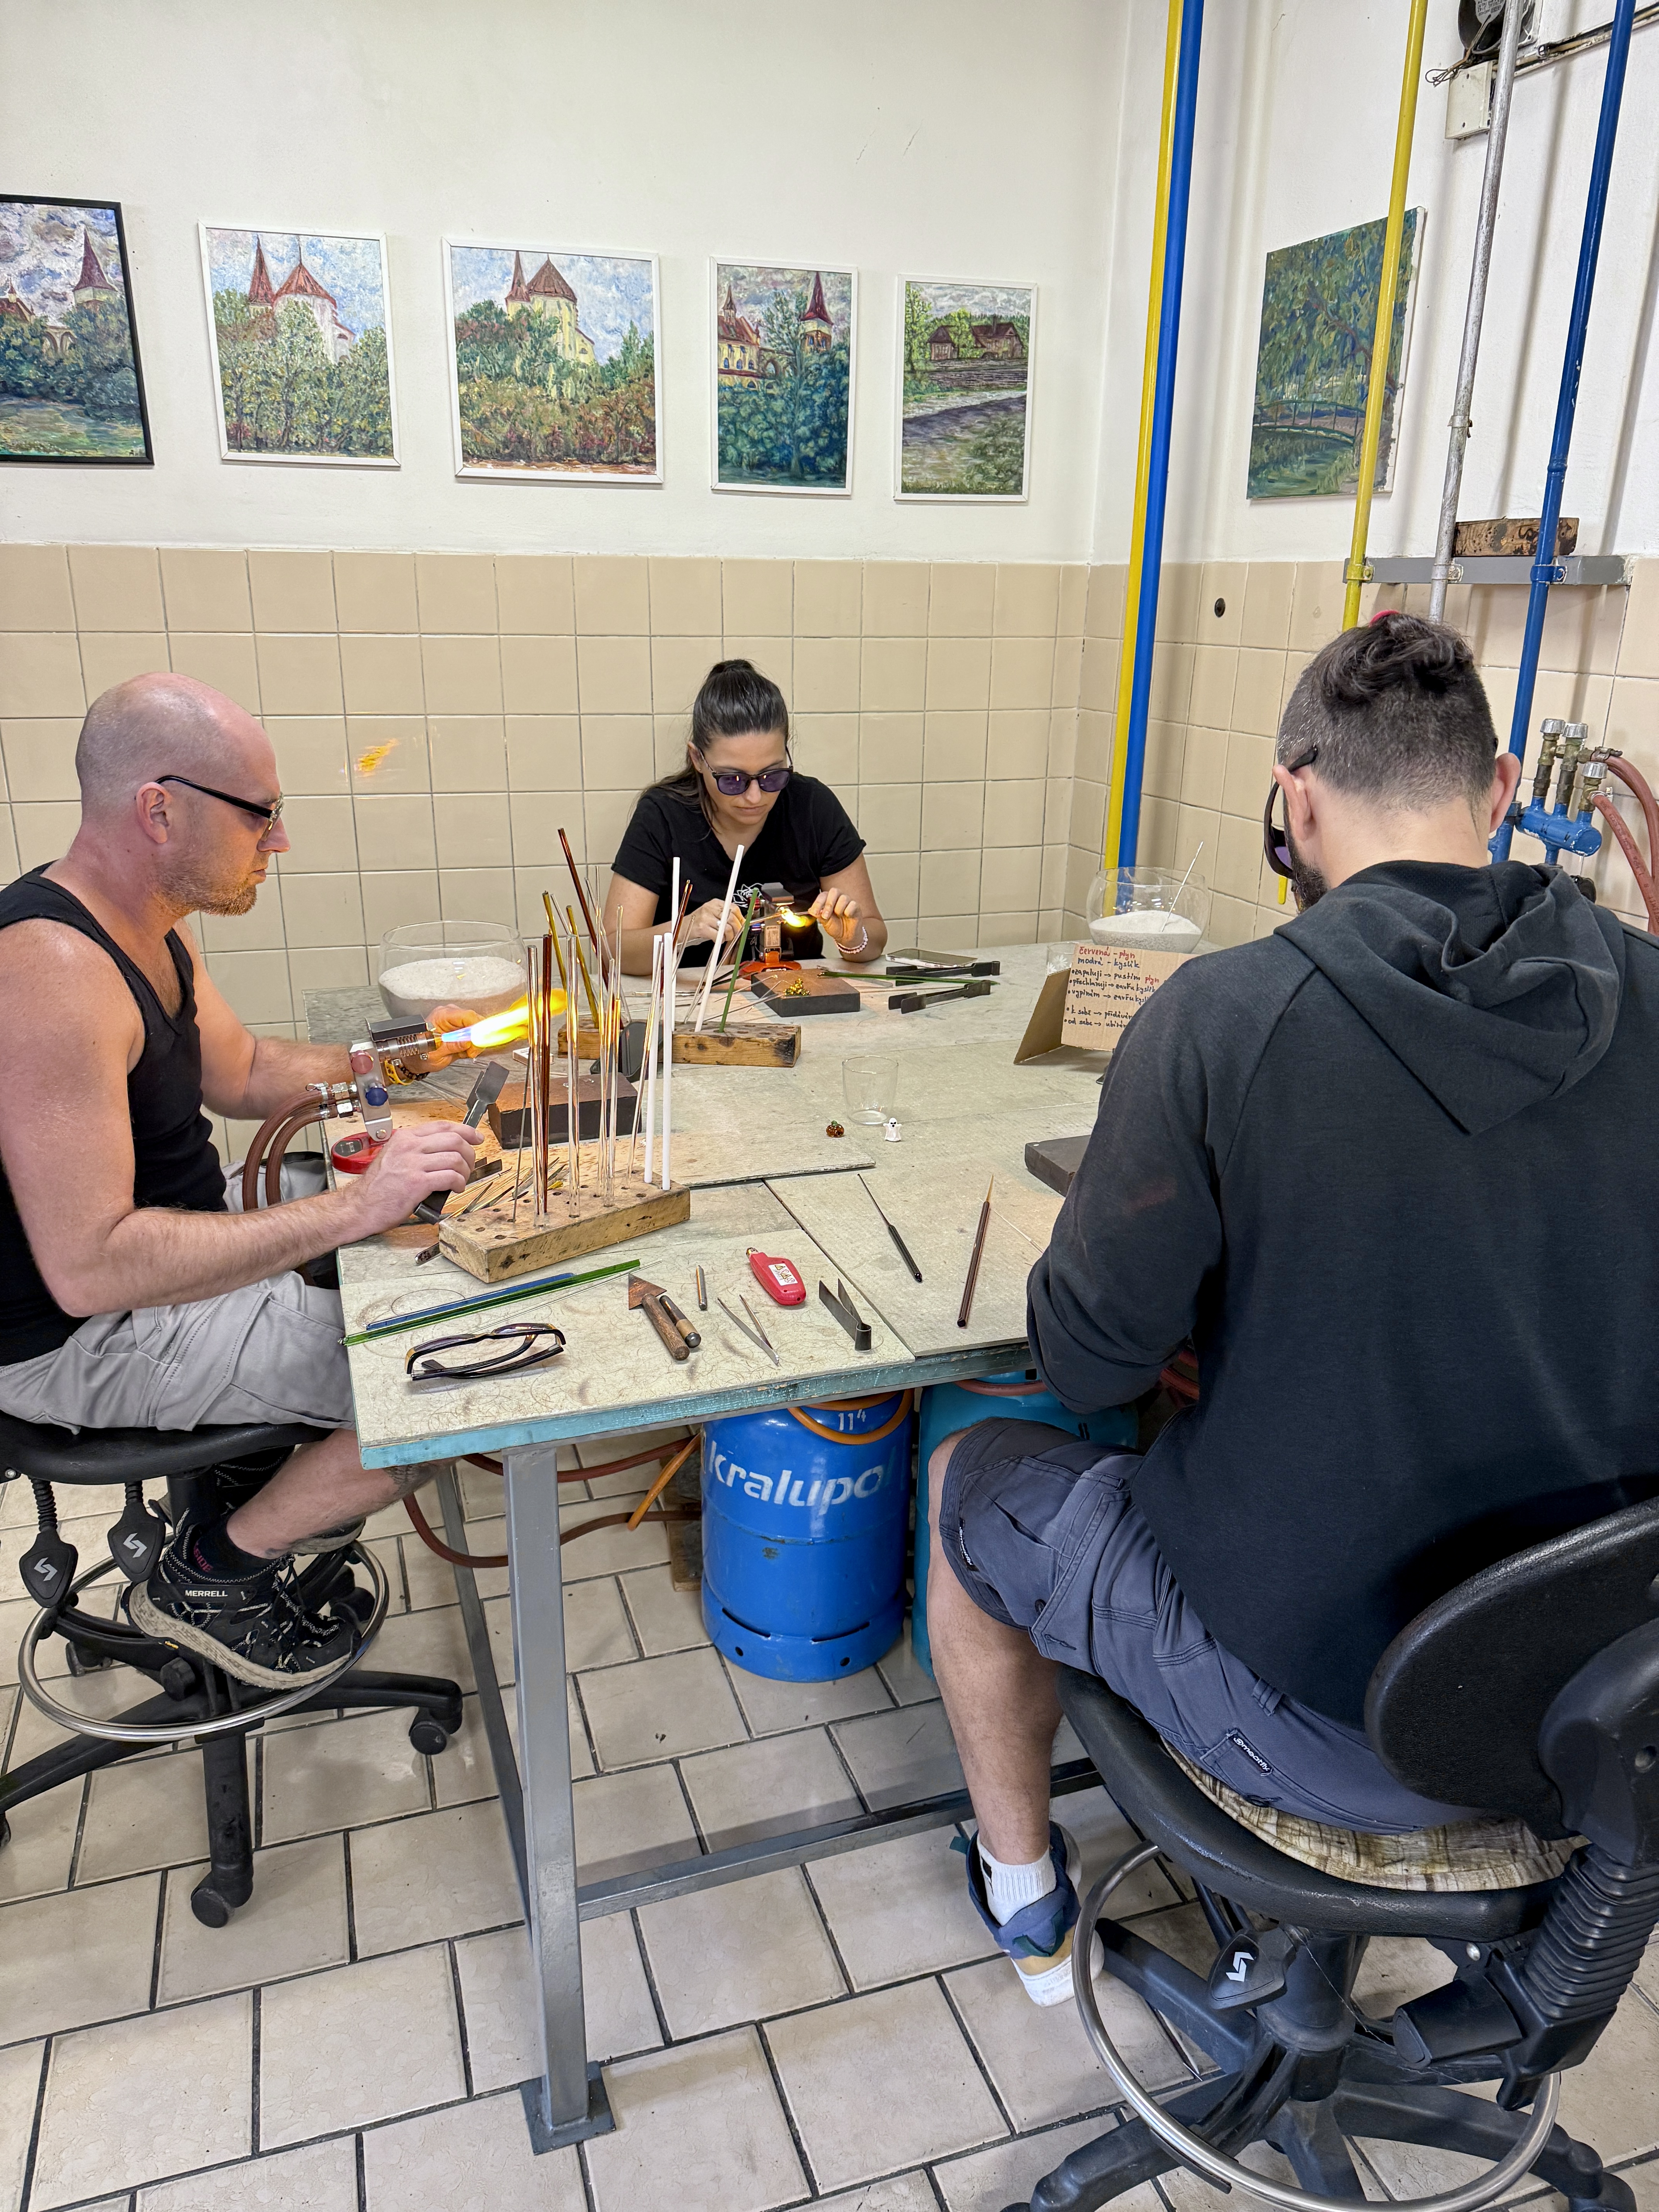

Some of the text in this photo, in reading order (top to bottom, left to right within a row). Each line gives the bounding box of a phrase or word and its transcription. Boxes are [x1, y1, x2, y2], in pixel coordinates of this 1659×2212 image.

[1119, 950, 1135, 960] plyn
[1078, 957, 1104, 966] modrá
[1145, 975, 1159, 985] plyn
